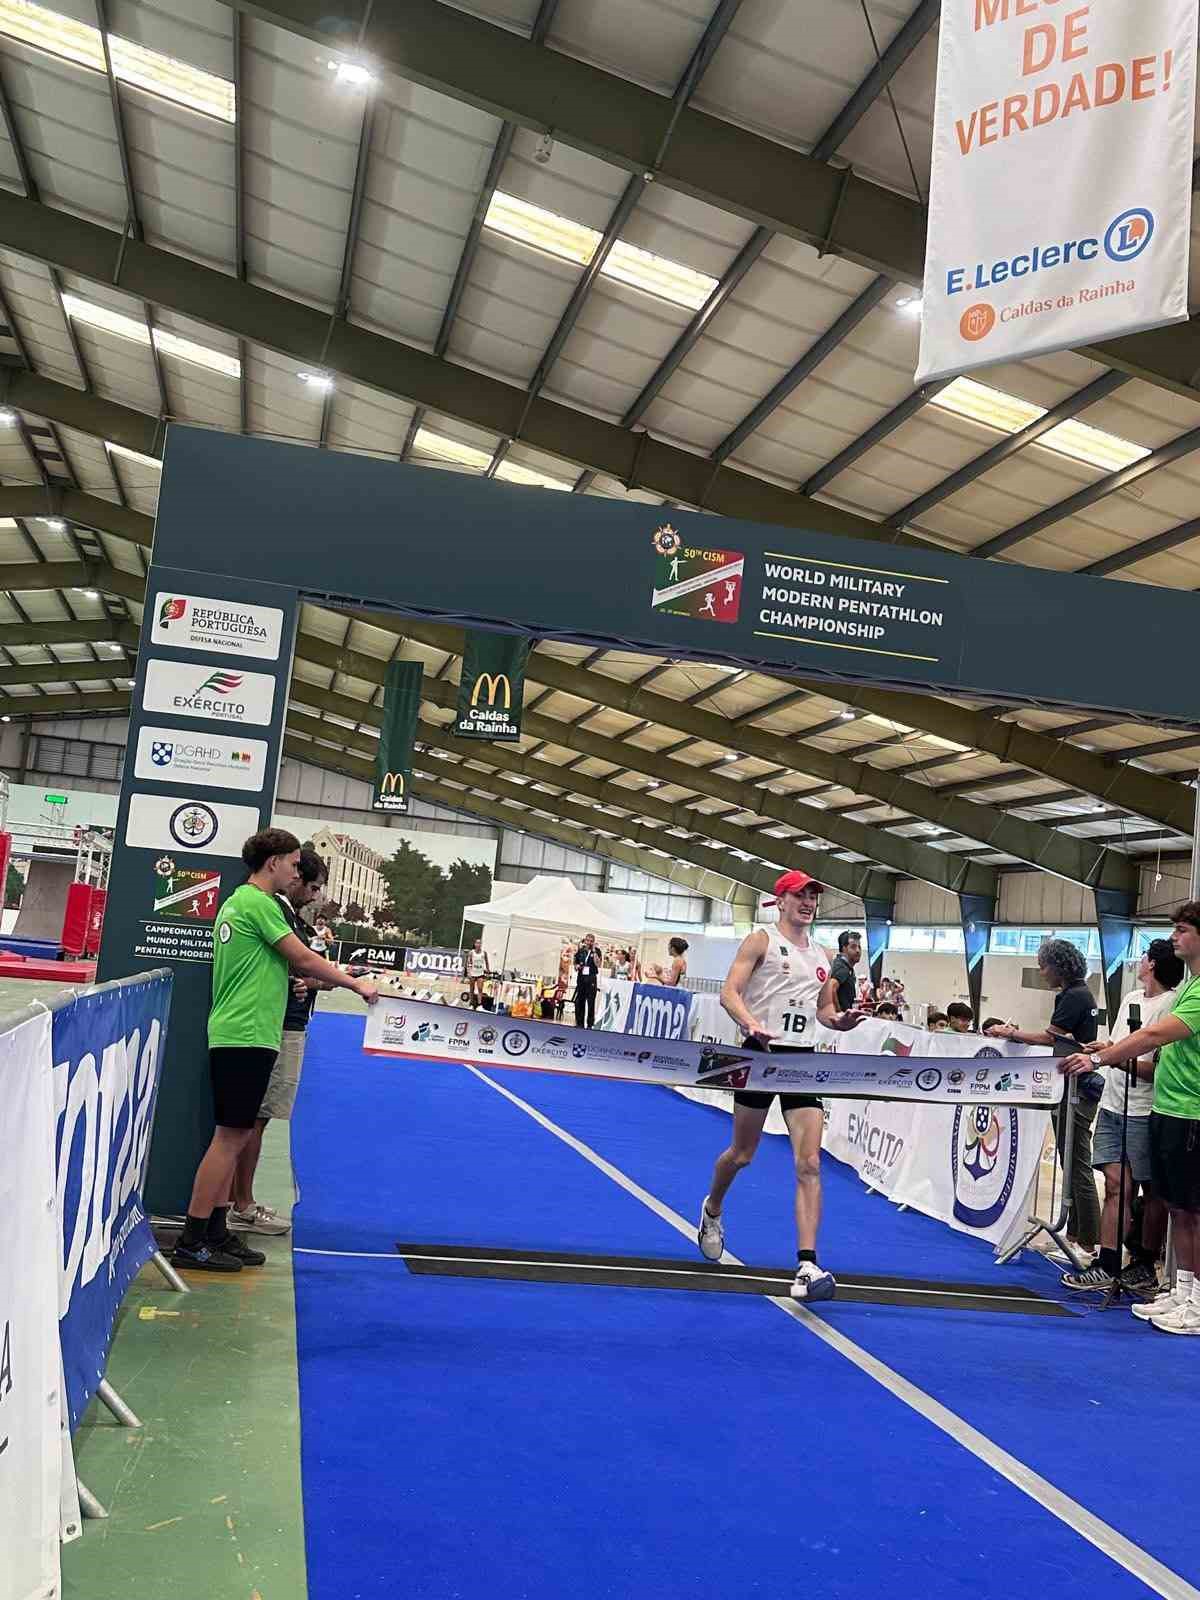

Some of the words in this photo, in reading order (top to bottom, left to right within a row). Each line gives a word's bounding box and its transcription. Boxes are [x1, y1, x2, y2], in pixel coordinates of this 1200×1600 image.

[1022, 6, 1090, 76] DE
[954, 48, 1174, 156] VERDADE!
[946, 237, 1099, 295] E.Leclerc
[1000, 298, 1053, 324] Caldas
[1055, 294, 1075, 309] da
[1078, 279, 1137, 304] Rainha
[703, 551, 725, 564] CISM
[764, 563, 826, 586] WORLD
[829, 573, 905, 598] MILITARY
[761, 586, 836, 610] MODERN
[838, 594, 944, 627] PENTATHLON
[192, 607, 255, 626] REPÚBLICA
[759, 609, 886, 641] CHAMPIONSHIP
[191, 617, 267, 638] PORTUGUESA
[469, 709, 510, 722] Caldas
[459, 719, 474, 731] da
[476, 720, 518, 734] Rainha
[379, 795, 403, 803] Caldas
[383, 803, 406, 811] Rainha
[145, 925, 203, 937] CAMPEONATO
[135, 946, 178, 956] PENTATLO
[146, 936, 179, 946] MUNDO
[180, 939, 213, 949] MILITAR
[367, 949, 396, 962] RAM
[782, 1012, 808, 1034] 1B
[448, 1038, 470, 1047] FPPM
